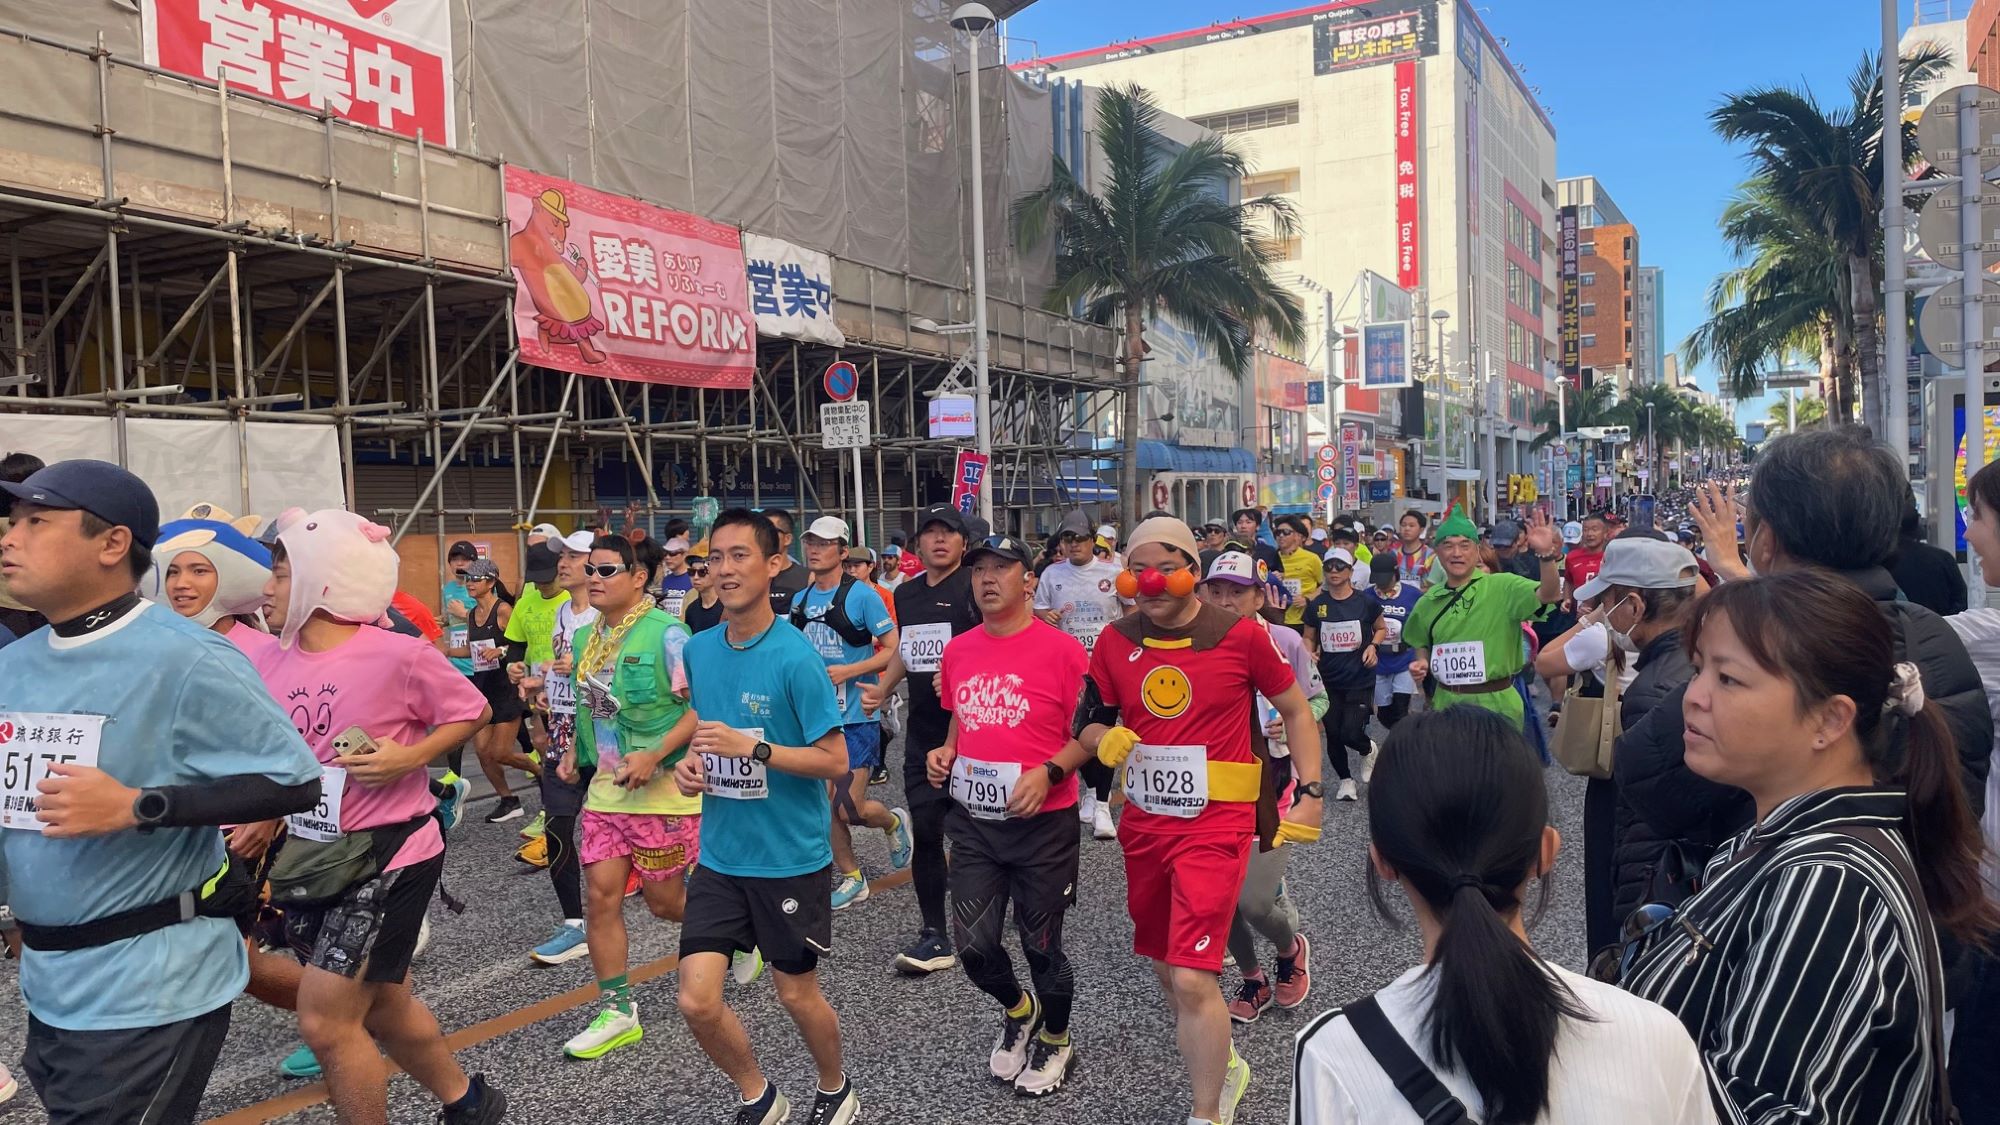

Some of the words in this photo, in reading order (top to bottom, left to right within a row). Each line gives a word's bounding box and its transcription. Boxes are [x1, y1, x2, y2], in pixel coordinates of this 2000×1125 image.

[199, 0, 415, 129] 営業中
[1400, 87, 1411, 108] Tax
[1400, 110, 1411, 137] Free
[1402, 222, 1412, 243] Tax
[591, 235, 661, 289] 愛美
[663, 251, 701, 275] あいび
[1402, 245, 1413, 272] Free
[601, 292, 749, 351] REFORM
[1345, 446, 1356, 488] ダイコク
[911, 639, 944, 658] 8020
[1330, 631, 1356, 643] 4692
[1443, 655, 1477, 672] 1064
[956, 686, 1031, 712] OKINAWA
[962, 703, 1026, 720] MARATHON
[976, 714, 1004, 724] 2024
[15, 726, 85, 746] 琉球銀行
[4, 751, 77, 792] 517
[1126, 766, 1135, 789] C
[1141, 768, 1195, 795] 1628
[964, 779, 1008, 804] 7991
[1161, 796, 1205, 807] NAHAマラソン
